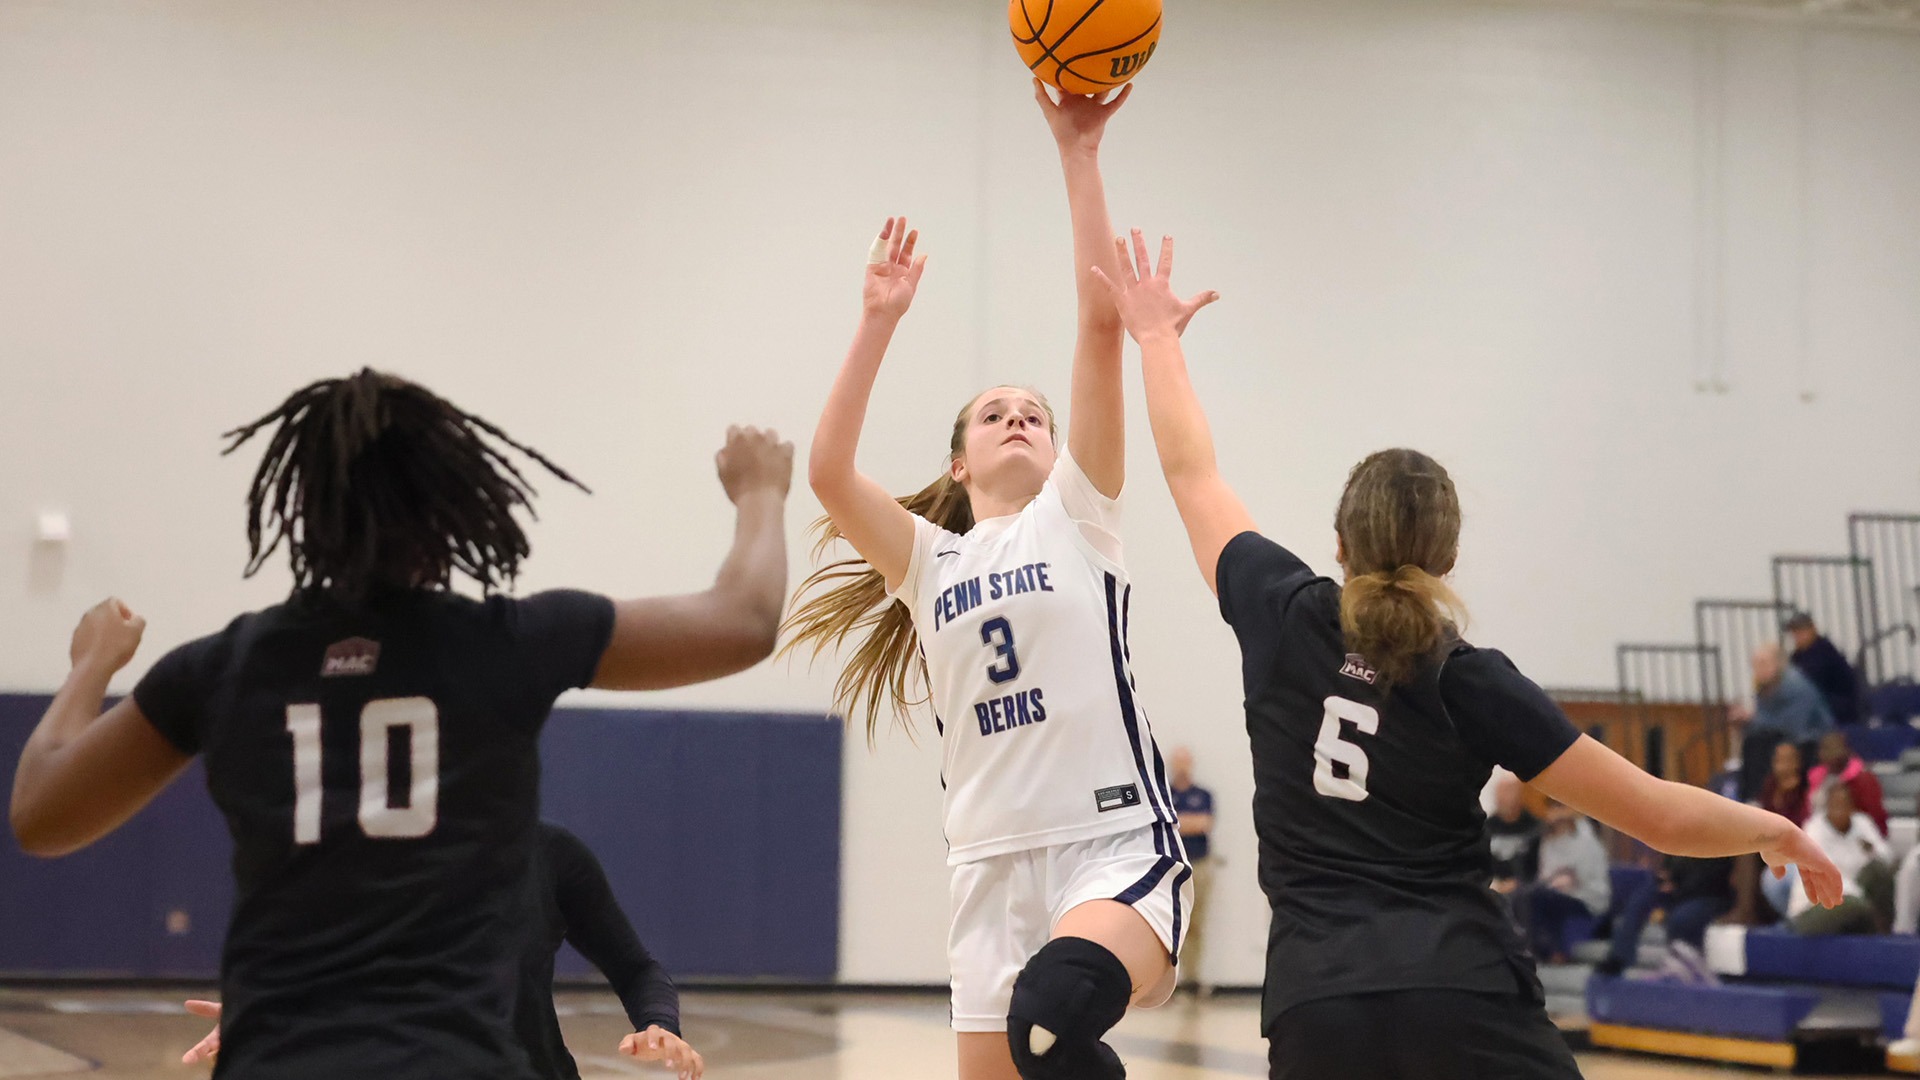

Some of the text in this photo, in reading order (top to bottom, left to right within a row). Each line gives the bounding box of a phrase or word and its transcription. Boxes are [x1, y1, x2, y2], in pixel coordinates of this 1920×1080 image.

[934, 562, 1054, 632] PENN STATE
[325, 654, 374, 672] MAC
[979, 614, 1022, 686] 3
[1344, 662, 1376, 681] MAC
[974, 687, 1047, 736] BERKS
[286, 696, 440, 844] 10
[1313, 695, 1380, 802] 6
[1125, 790, 1134, 800] S
